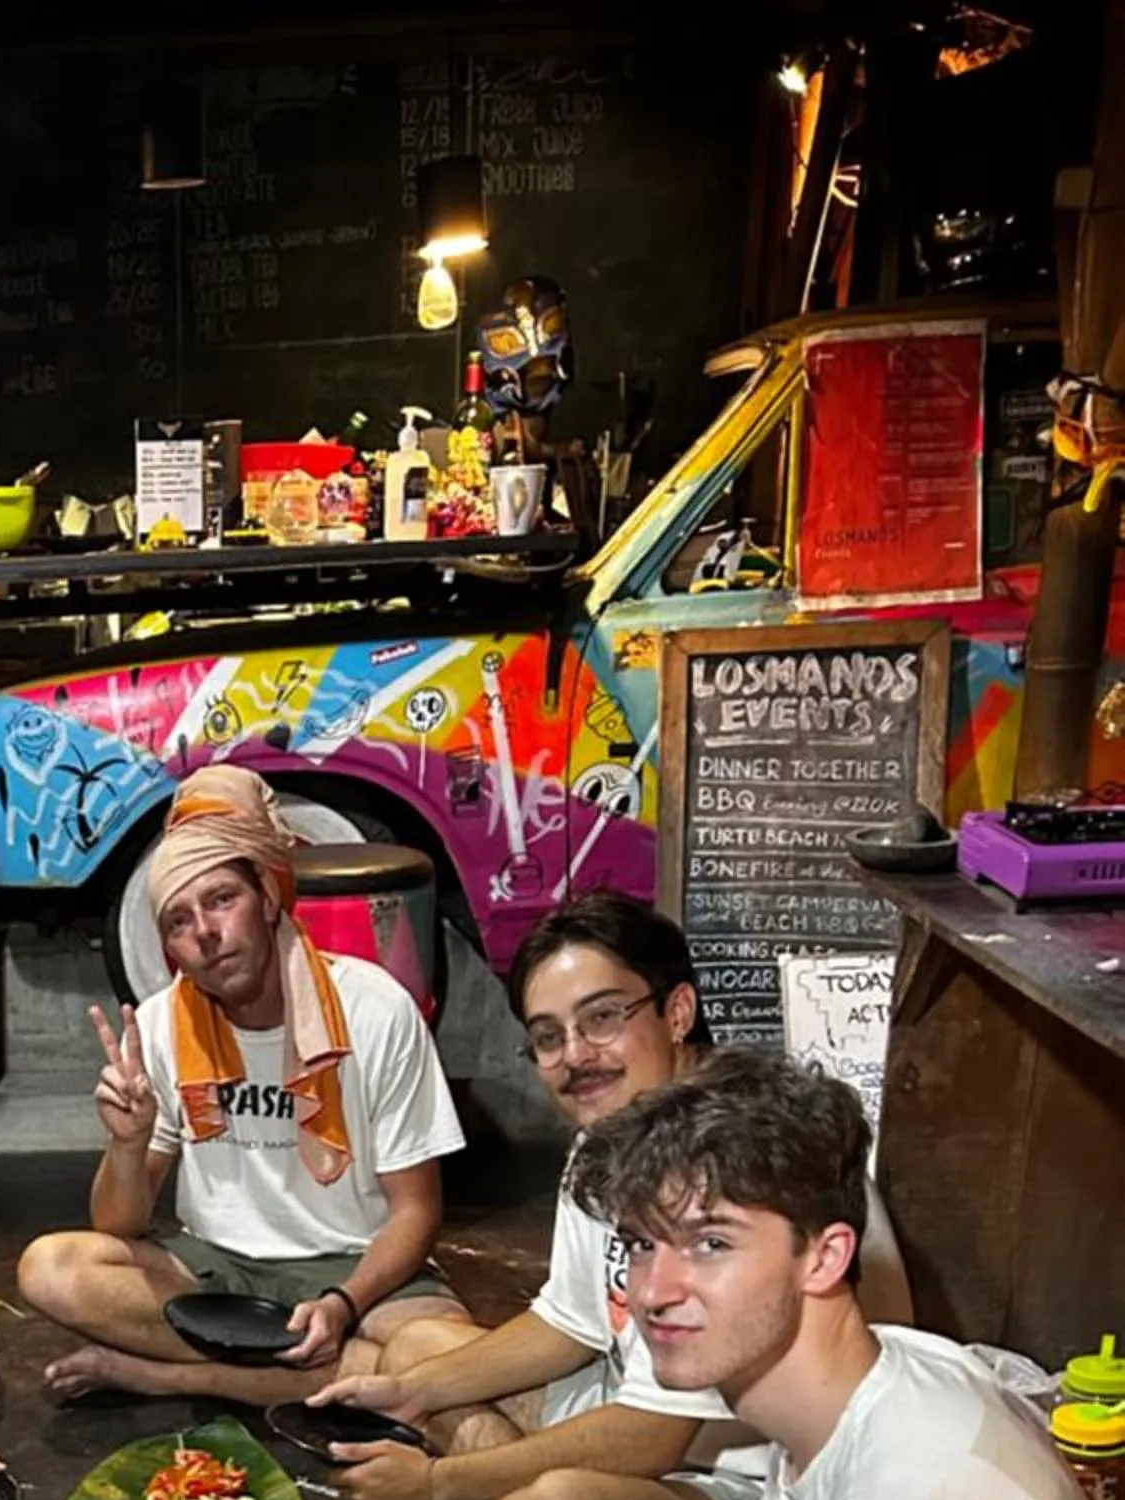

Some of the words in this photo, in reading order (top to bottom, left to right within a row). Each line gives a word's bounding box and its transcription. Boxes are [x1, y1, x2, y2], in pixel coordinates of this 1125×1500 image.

[691, 653, 918, 701] LOSMANOS
[718, 697, 872, 737] EVENTS
[698, 756, 781, 780] DINNER
[791, 759, 902, 780] TOGETHER
[697, 786, 756, 812] BBQ
[764, 829, 828, 847] BEACH
[690, 857, 795, 878] BONEFIRE
[691, 891, 772, 912] SUNSET
[689, 942, 769, 958] COOKING
[848, 1003, 891, 1024] ACT
